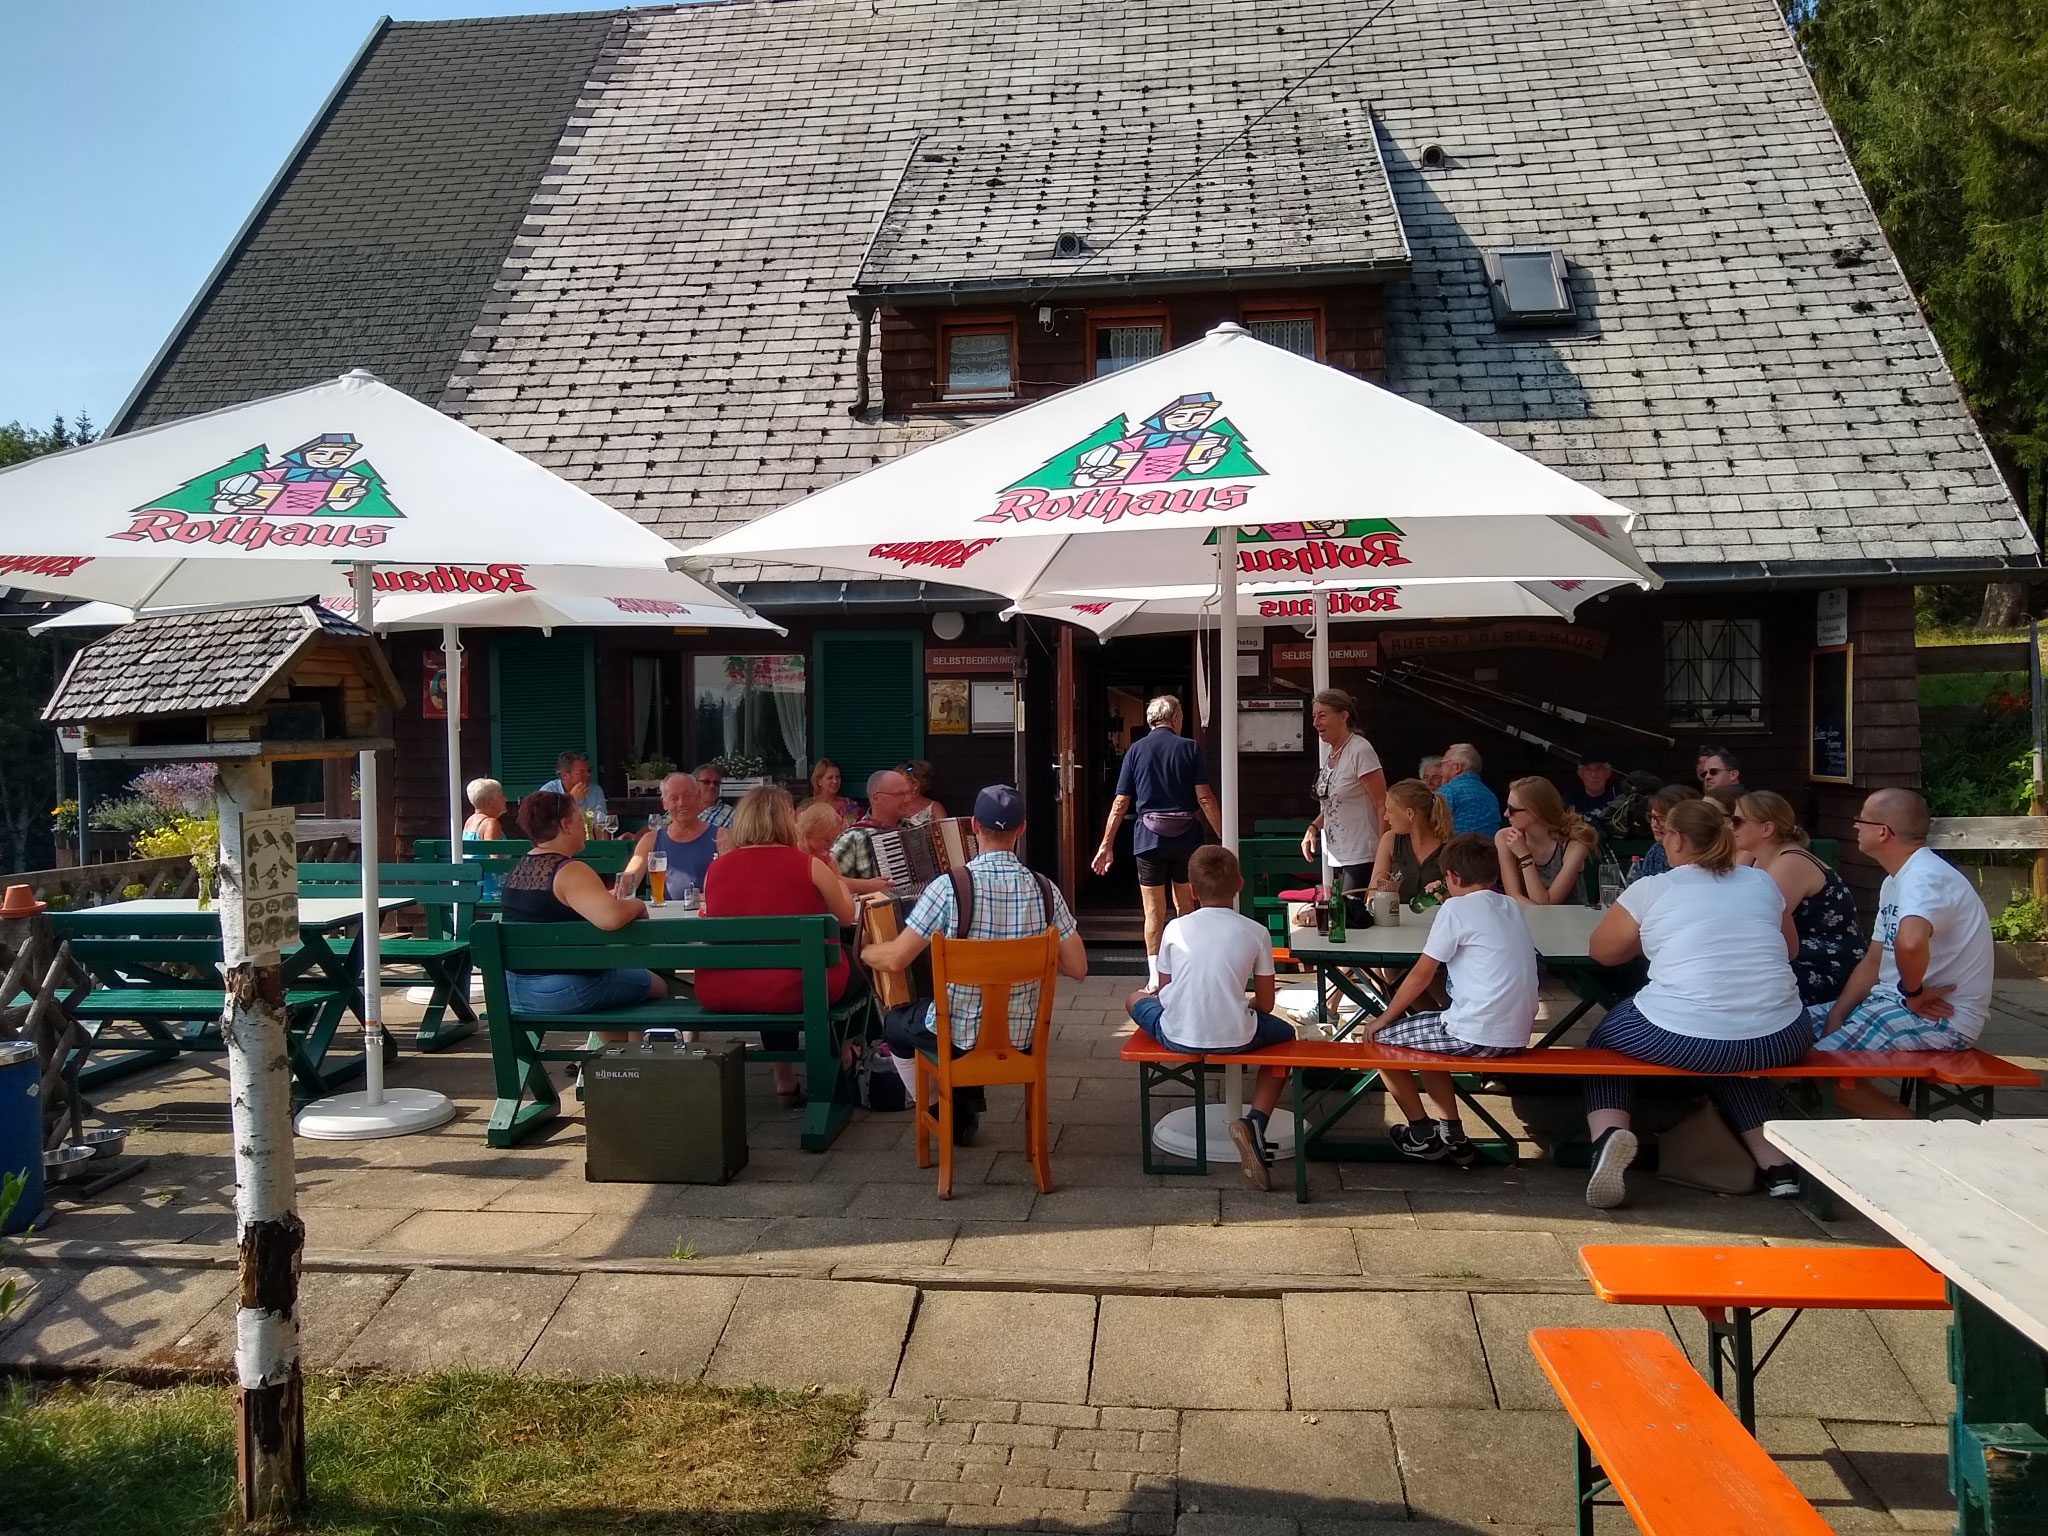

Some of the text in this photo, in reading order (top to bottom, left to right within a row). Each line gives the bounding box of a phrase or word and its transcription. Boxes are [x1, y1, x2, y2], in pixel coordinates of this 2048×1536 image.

[974, 485, 1257, 524] Rothaus
[105, 509, 395, 551] Rothaus
[1551, 630, 1594, 650] HAUS
[1282, 650, 1368, 660] SELBSDIENUNG
[595, 1070, 640, 1078] SÜDKLANG
